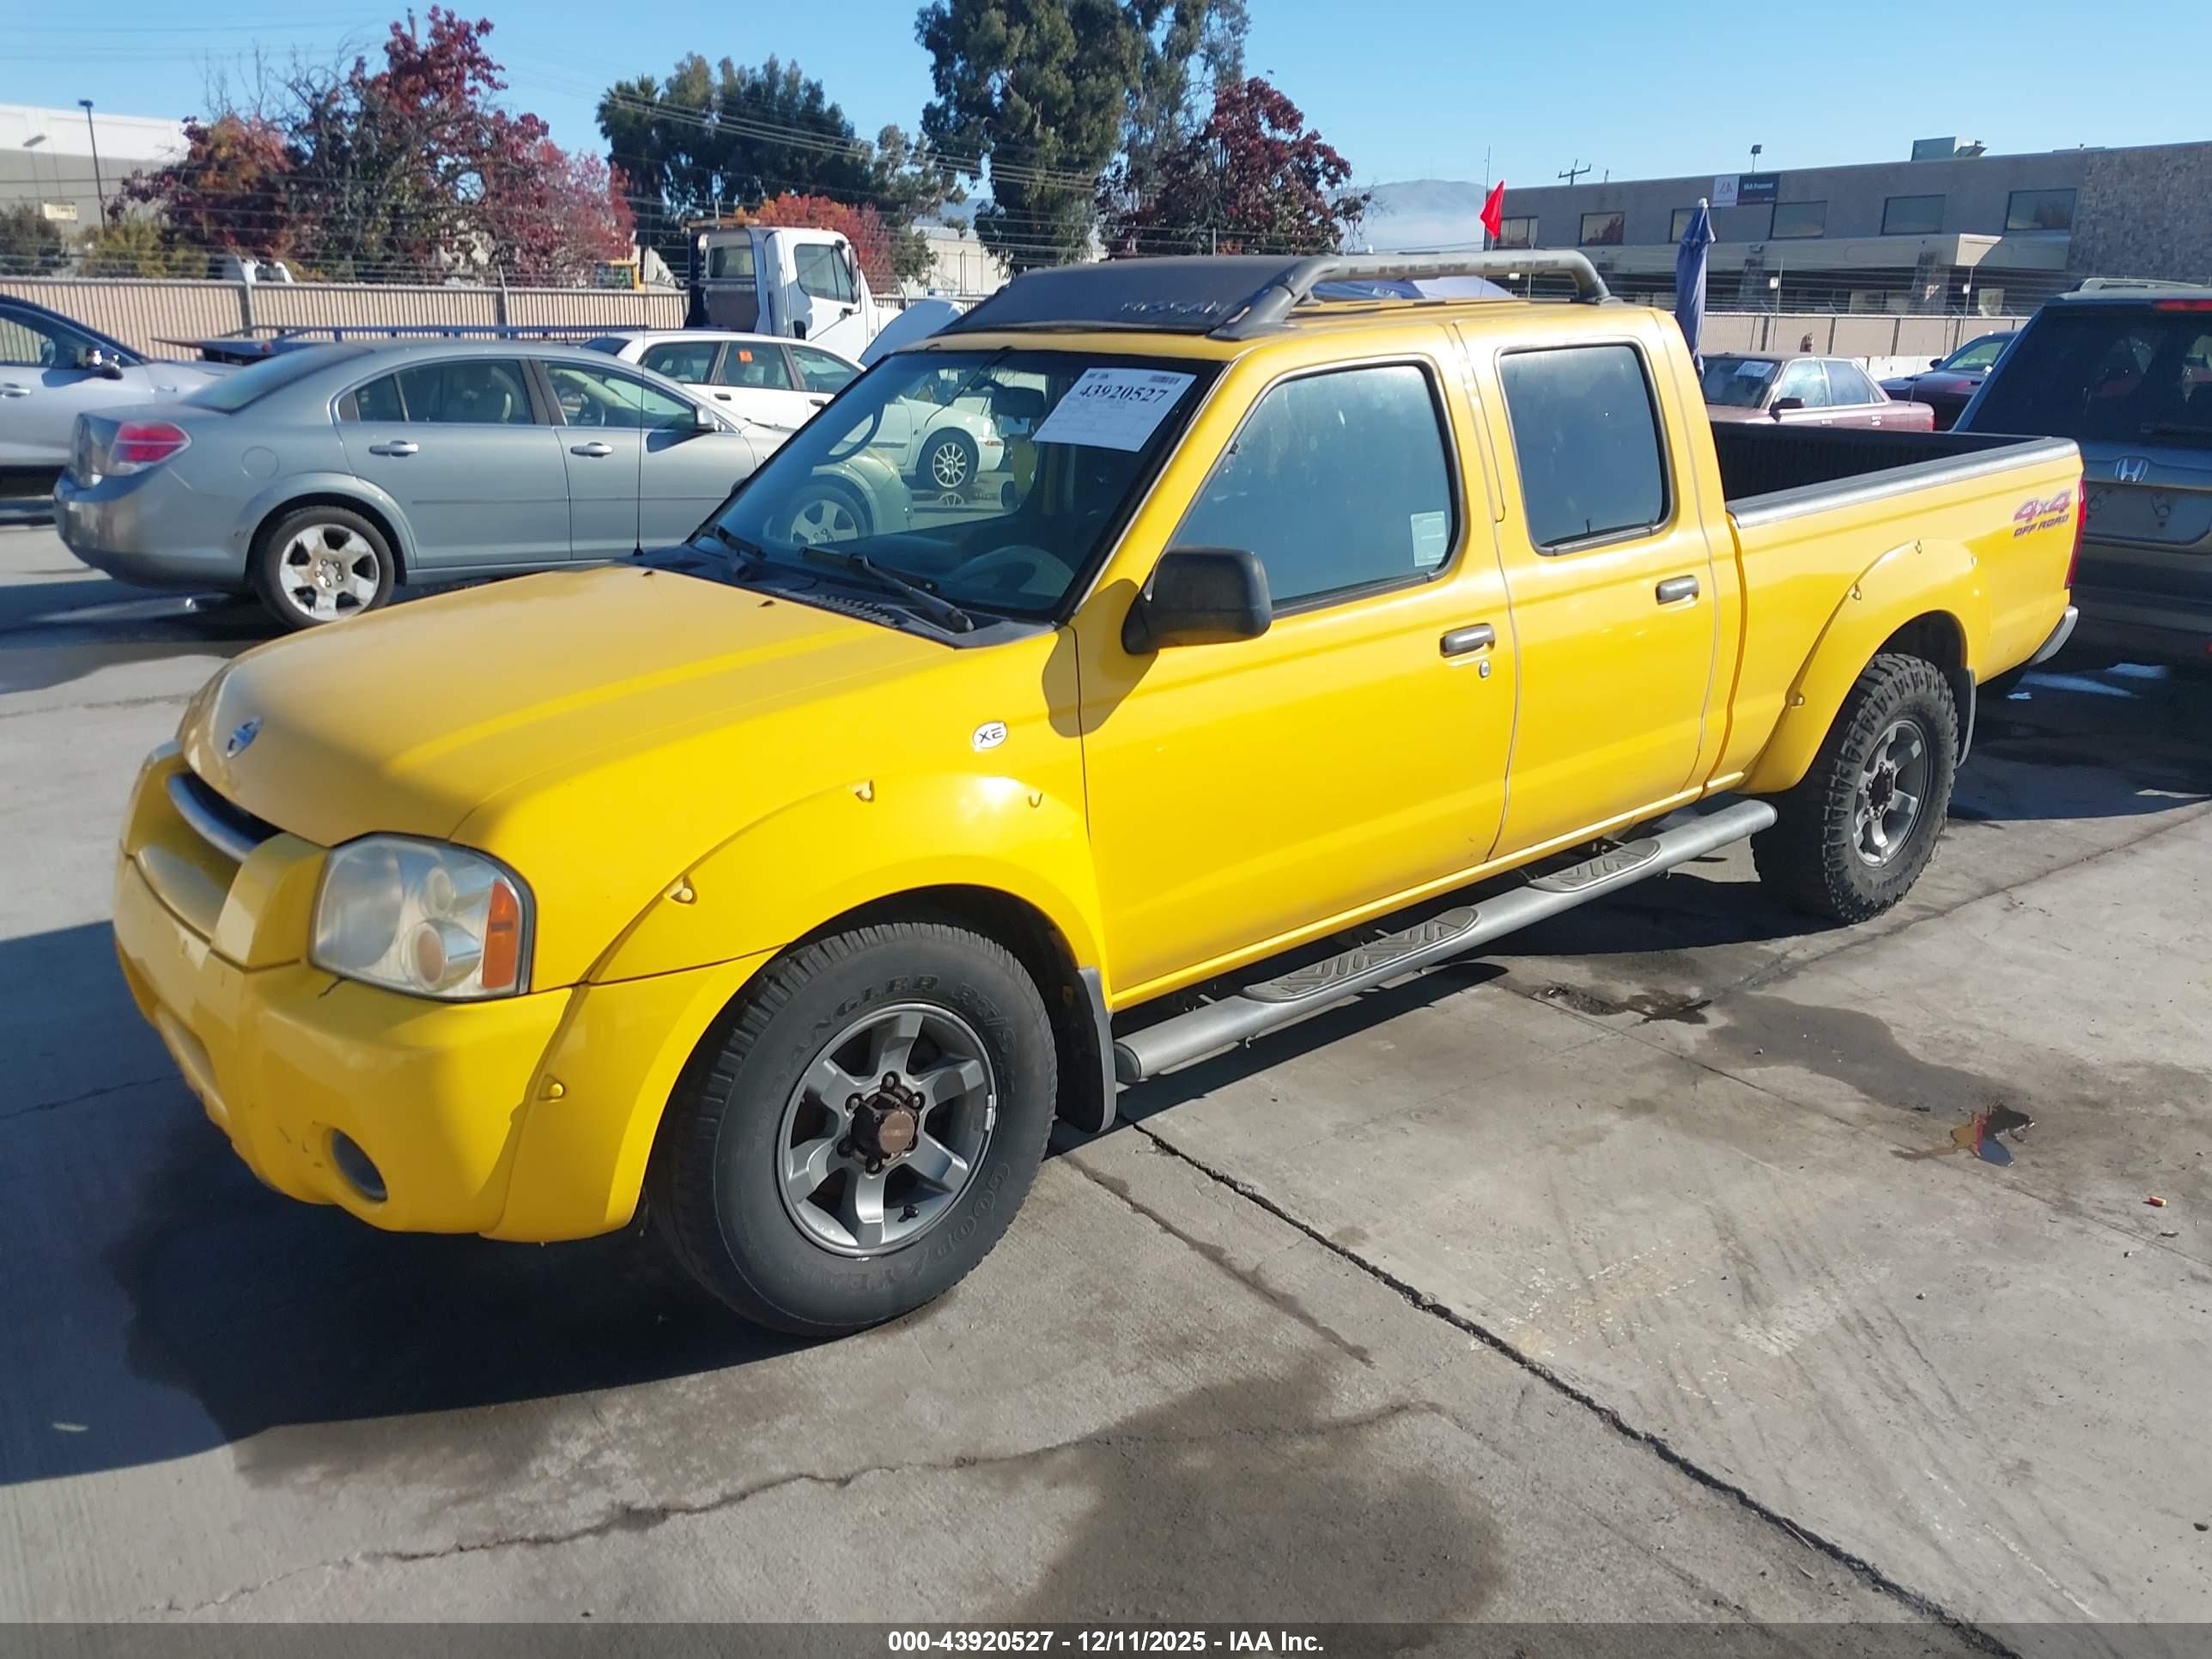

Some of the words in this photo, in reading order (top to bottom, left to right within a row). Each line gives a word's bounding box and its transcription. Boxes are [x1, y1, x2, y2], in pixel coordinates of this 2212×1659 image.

[1079, 385, 1170, 404] 43920527
[2014, 489, 2071, 521] 4x4
[2014, 522, 2037, 538] OFF
[2038, 514, 2069, 532] ROAD
[978, 726, 1004, 744] XE
